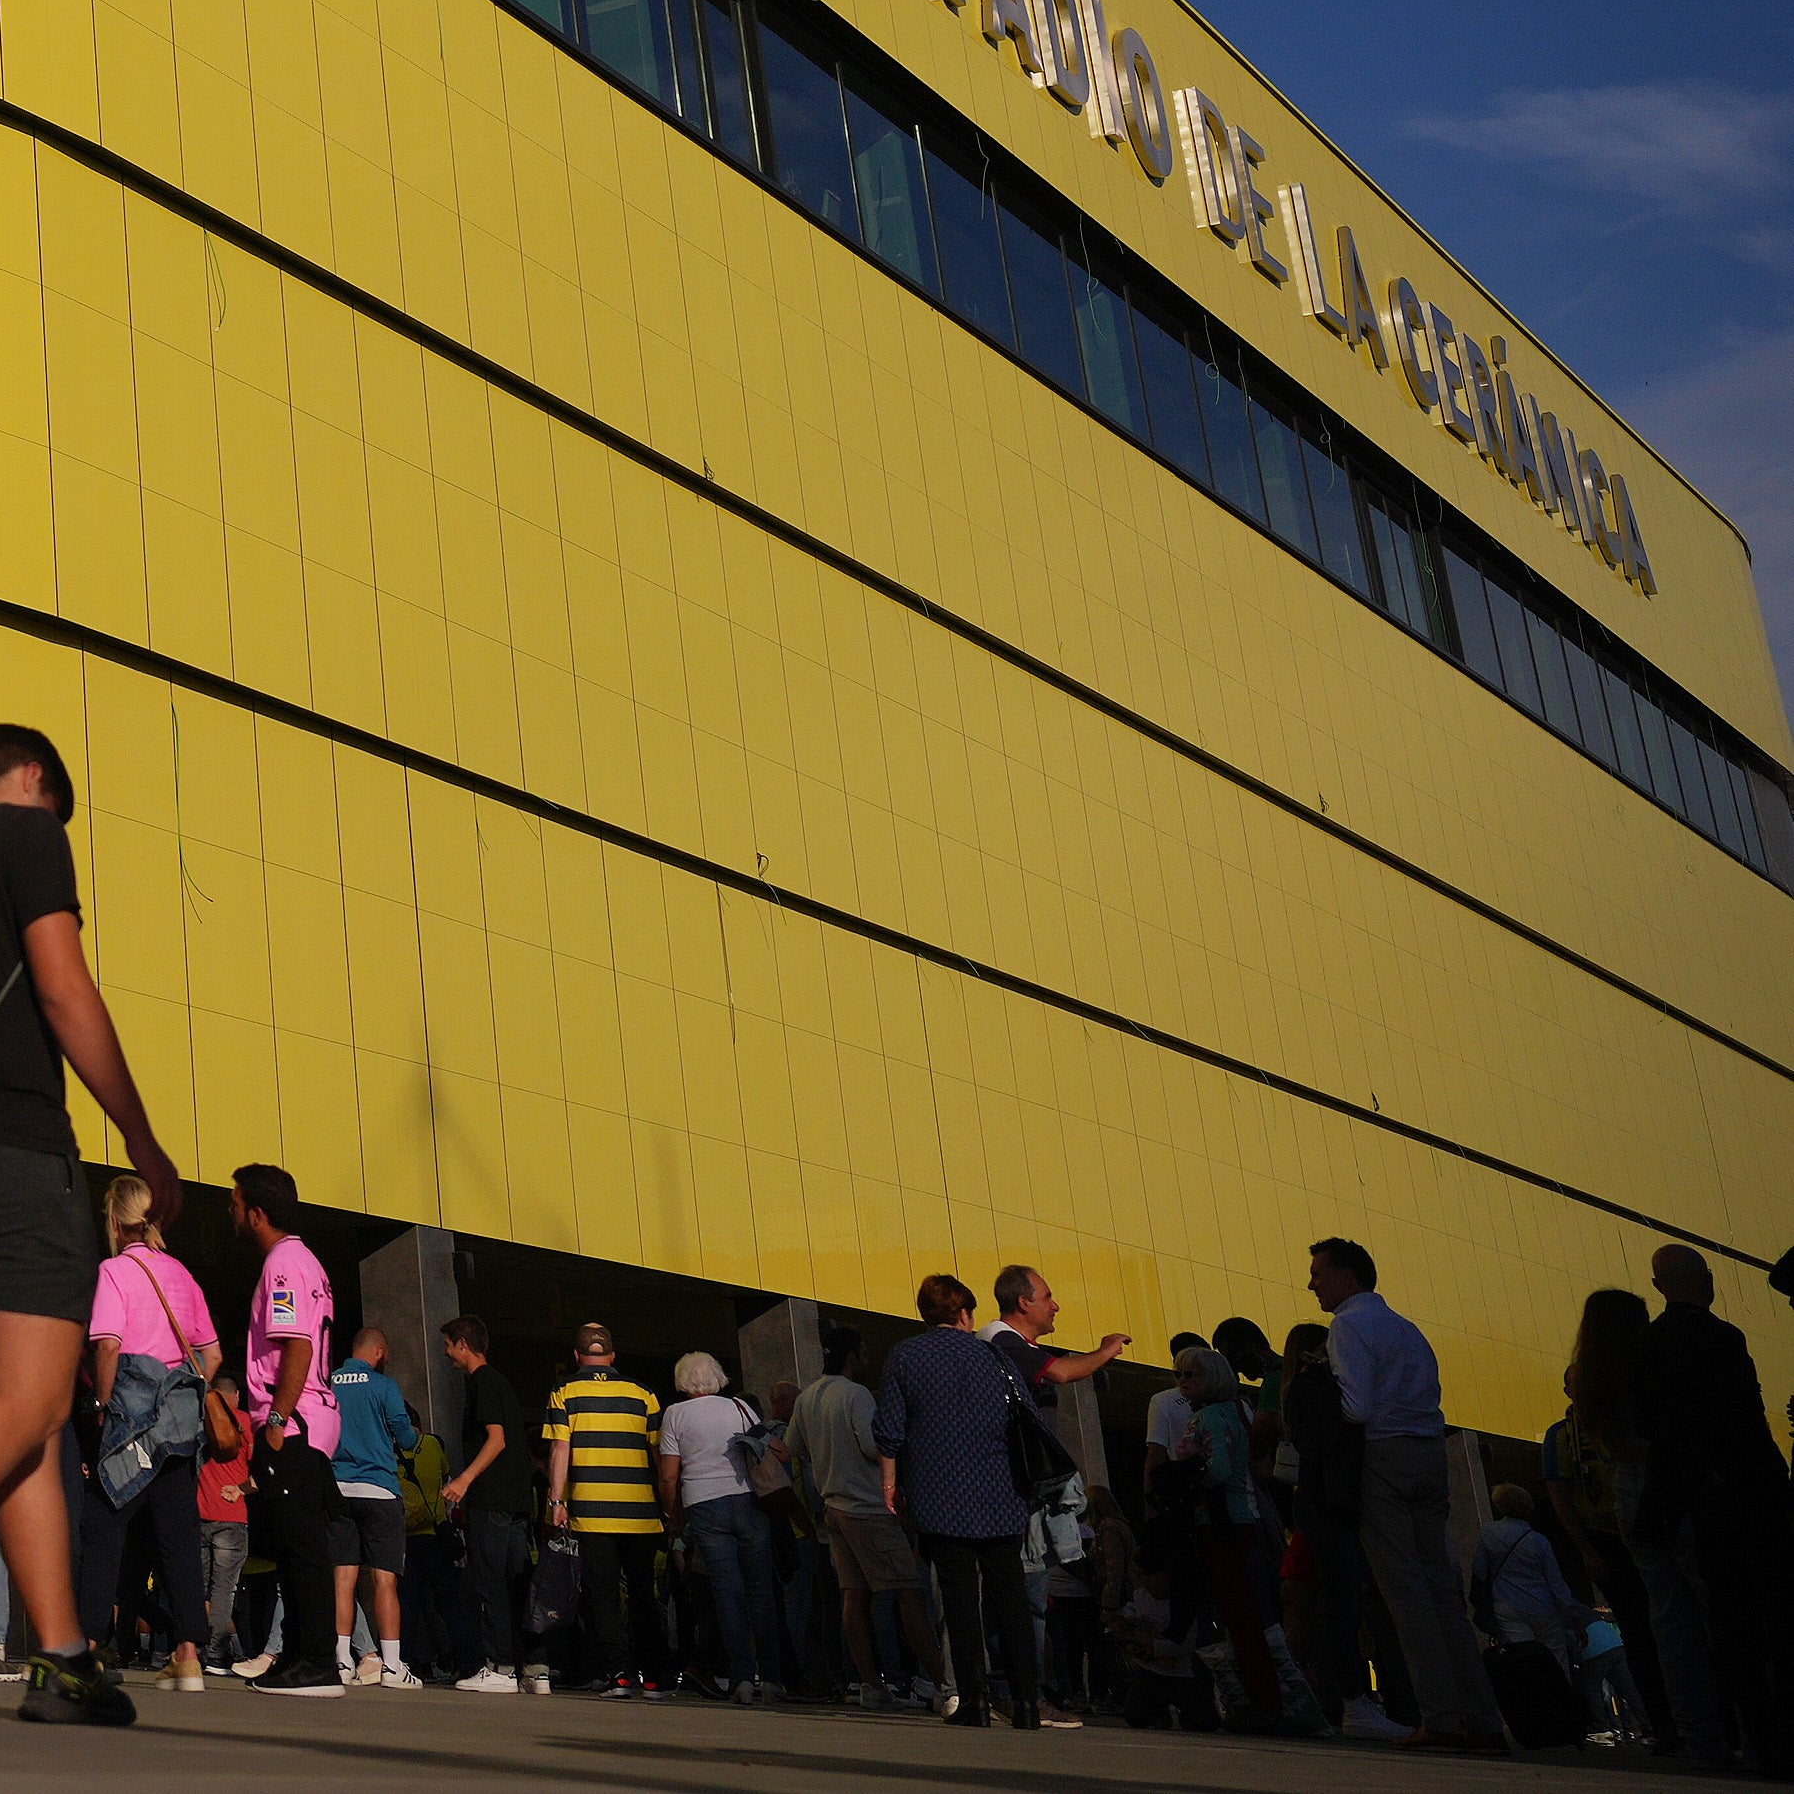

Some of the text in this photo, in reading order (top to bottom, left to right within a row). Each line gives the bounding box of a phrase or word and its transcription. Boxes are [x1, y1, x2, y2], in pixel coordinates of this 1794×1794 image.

[1173, 86, 1289, 284] DE
[1278, 182, 1389, 371] LA
[1387, 277, 1658, 597] CERÁMICA
[331, 1372, 369, 1384] oma
